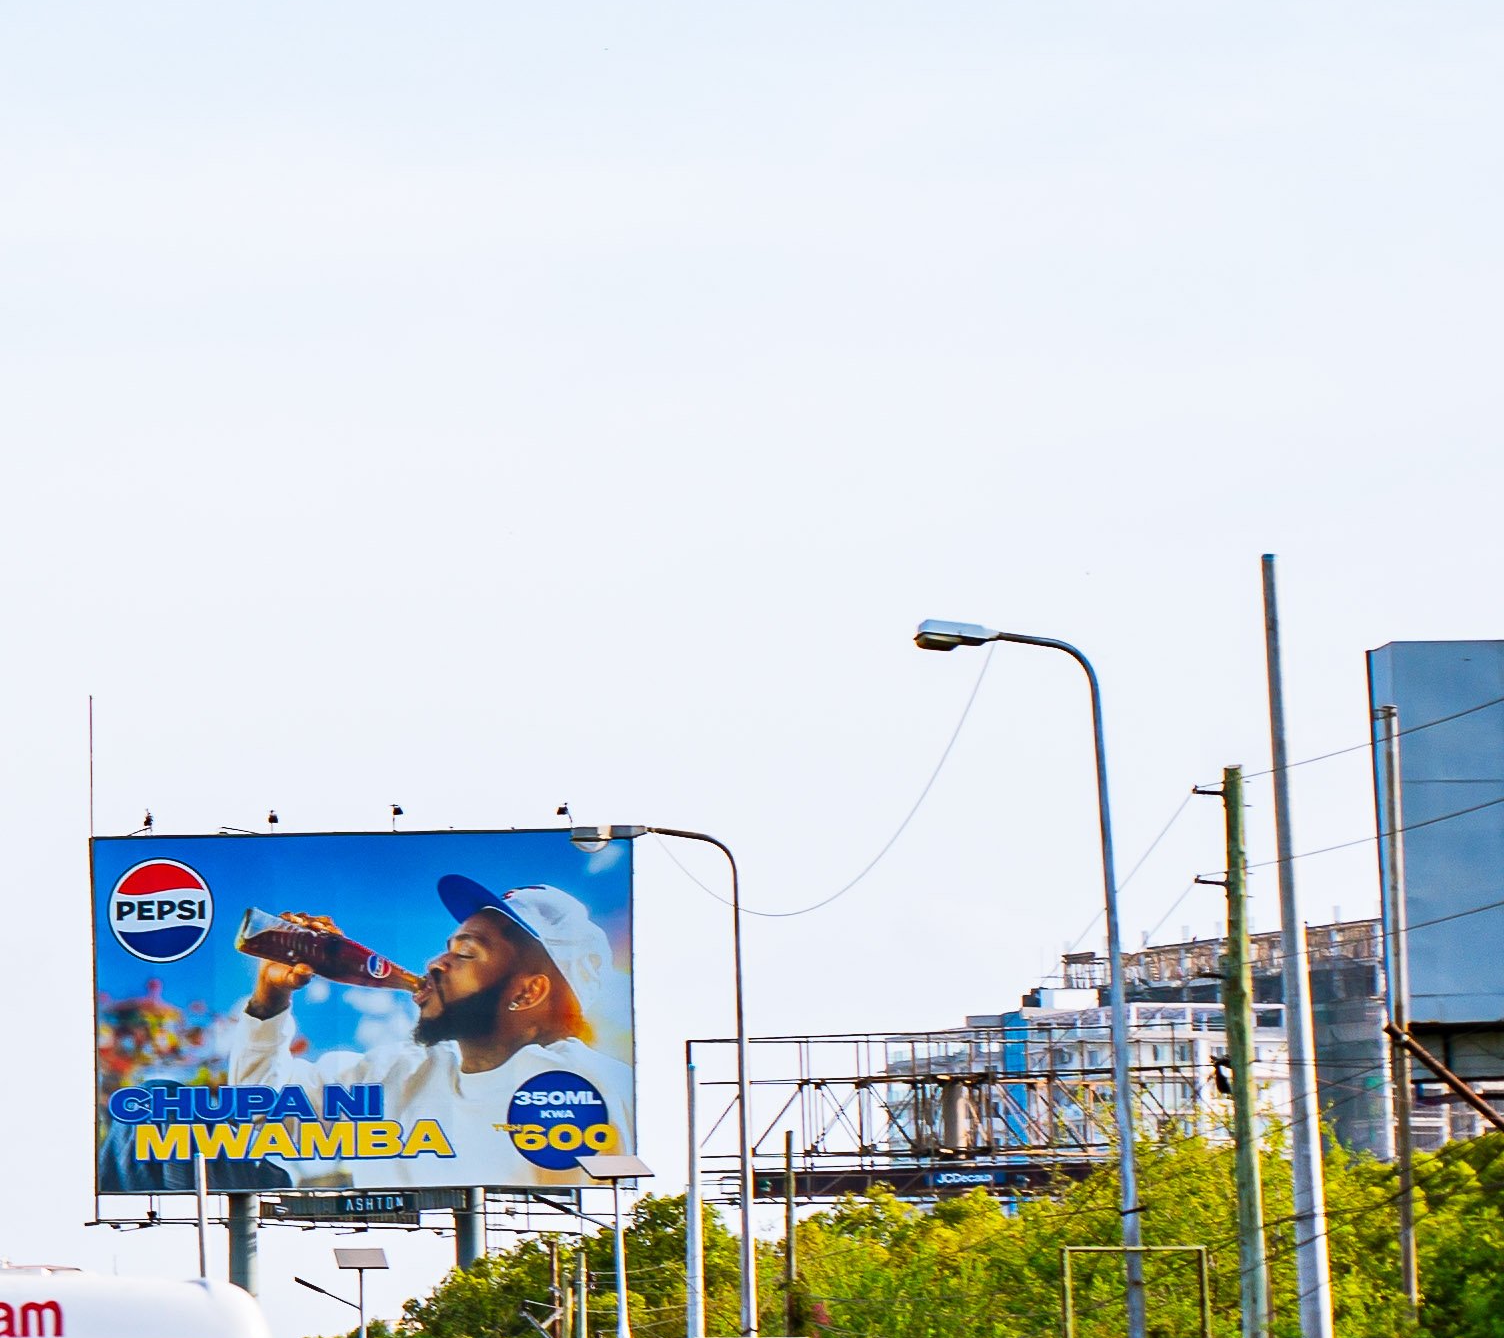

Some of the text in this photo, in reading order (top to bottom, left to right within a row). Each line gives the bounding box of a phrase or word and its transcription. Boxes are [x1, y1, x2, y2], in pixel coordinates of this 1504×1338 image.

[116, 899, 206, 921] PEPSI
[108, 1082, 384, 1123] CHUPA NI
[514, 1090, 602, 1106] 350ML
[540, 1109, 576, 1119] KWA
[135, 1118, 456, 1162] MWAMBA
[513, 1123, 619, 1152] 600
